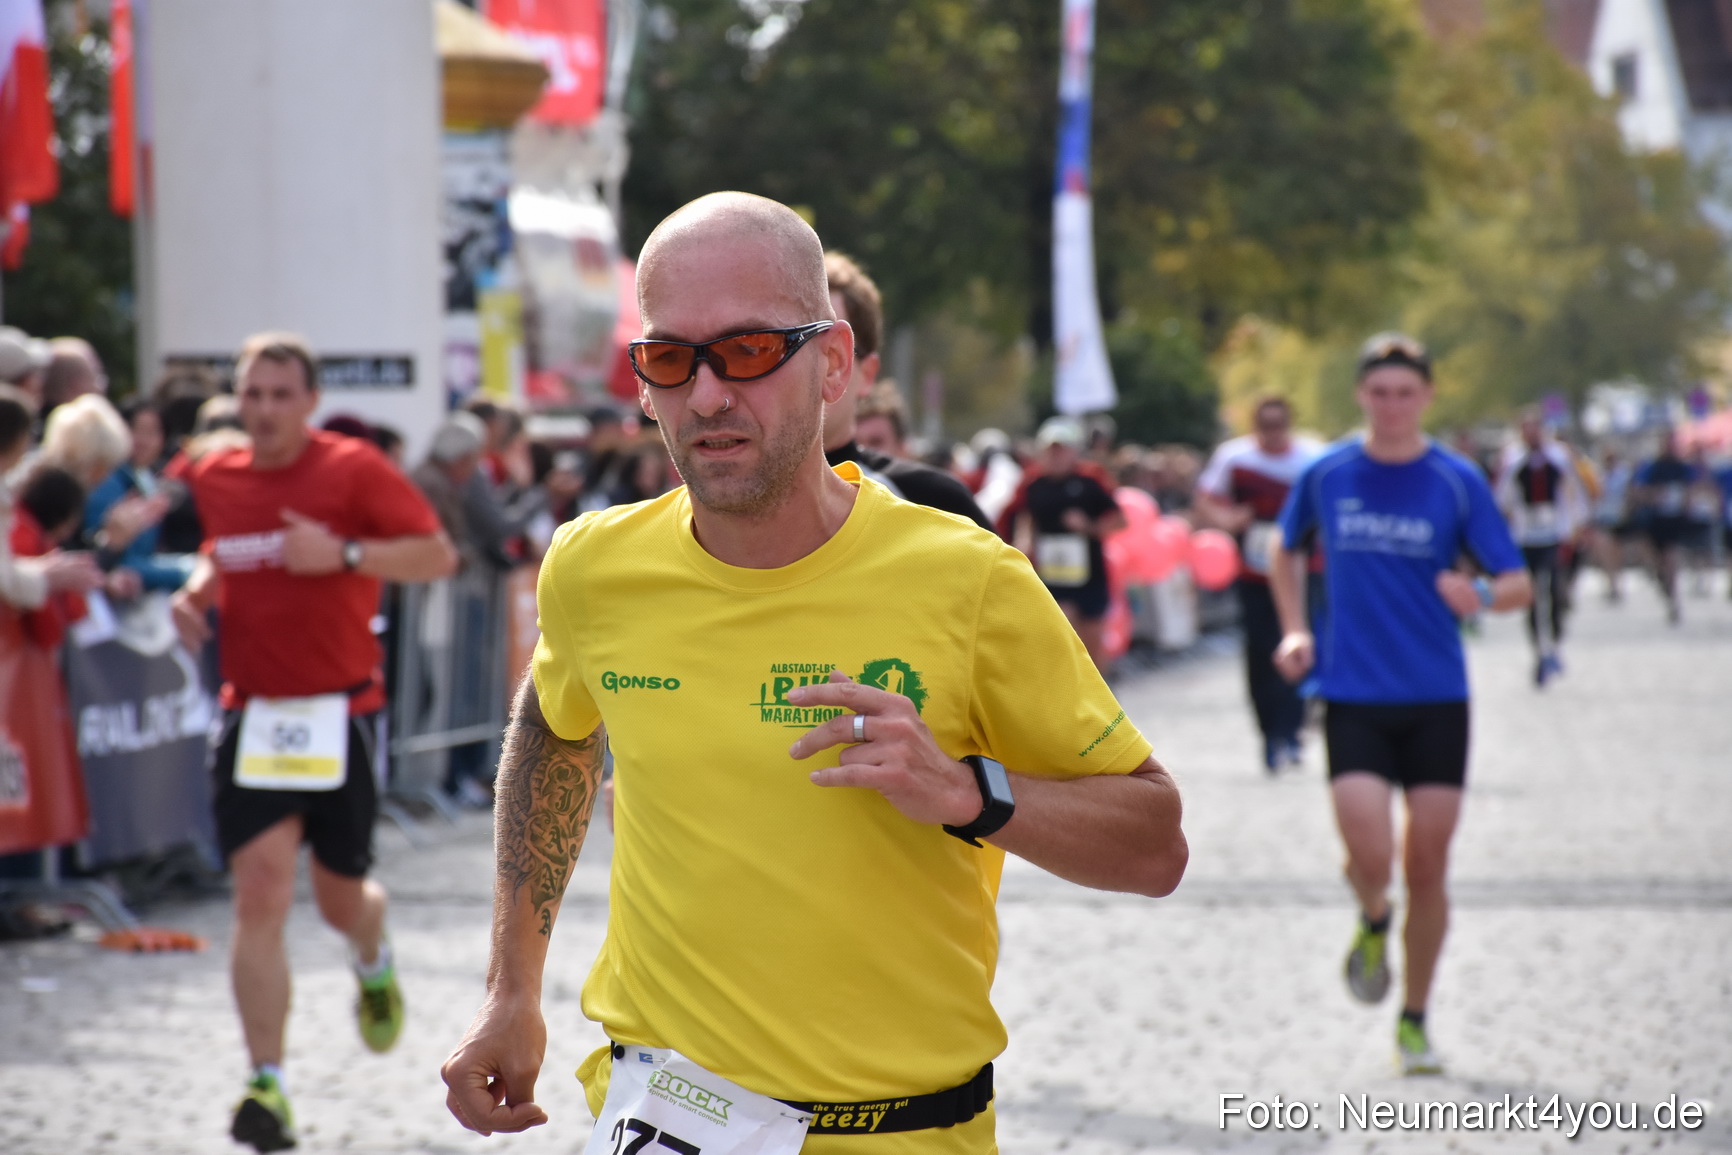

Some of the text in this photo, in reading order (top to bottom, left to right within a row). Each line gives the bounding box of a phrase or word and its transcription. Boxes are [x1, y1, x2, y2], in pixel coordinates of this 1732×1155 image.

[770, 663, 836, 674] ALBSTADT-LBS
[812, 1104, 829, 1112] the
[858, 1102, 891, 1111] energy
[894, 1099, 909, 1110] gel
[678, 1101, 698, 1114] smart
[697, 1111, 728, 1127] concepts
